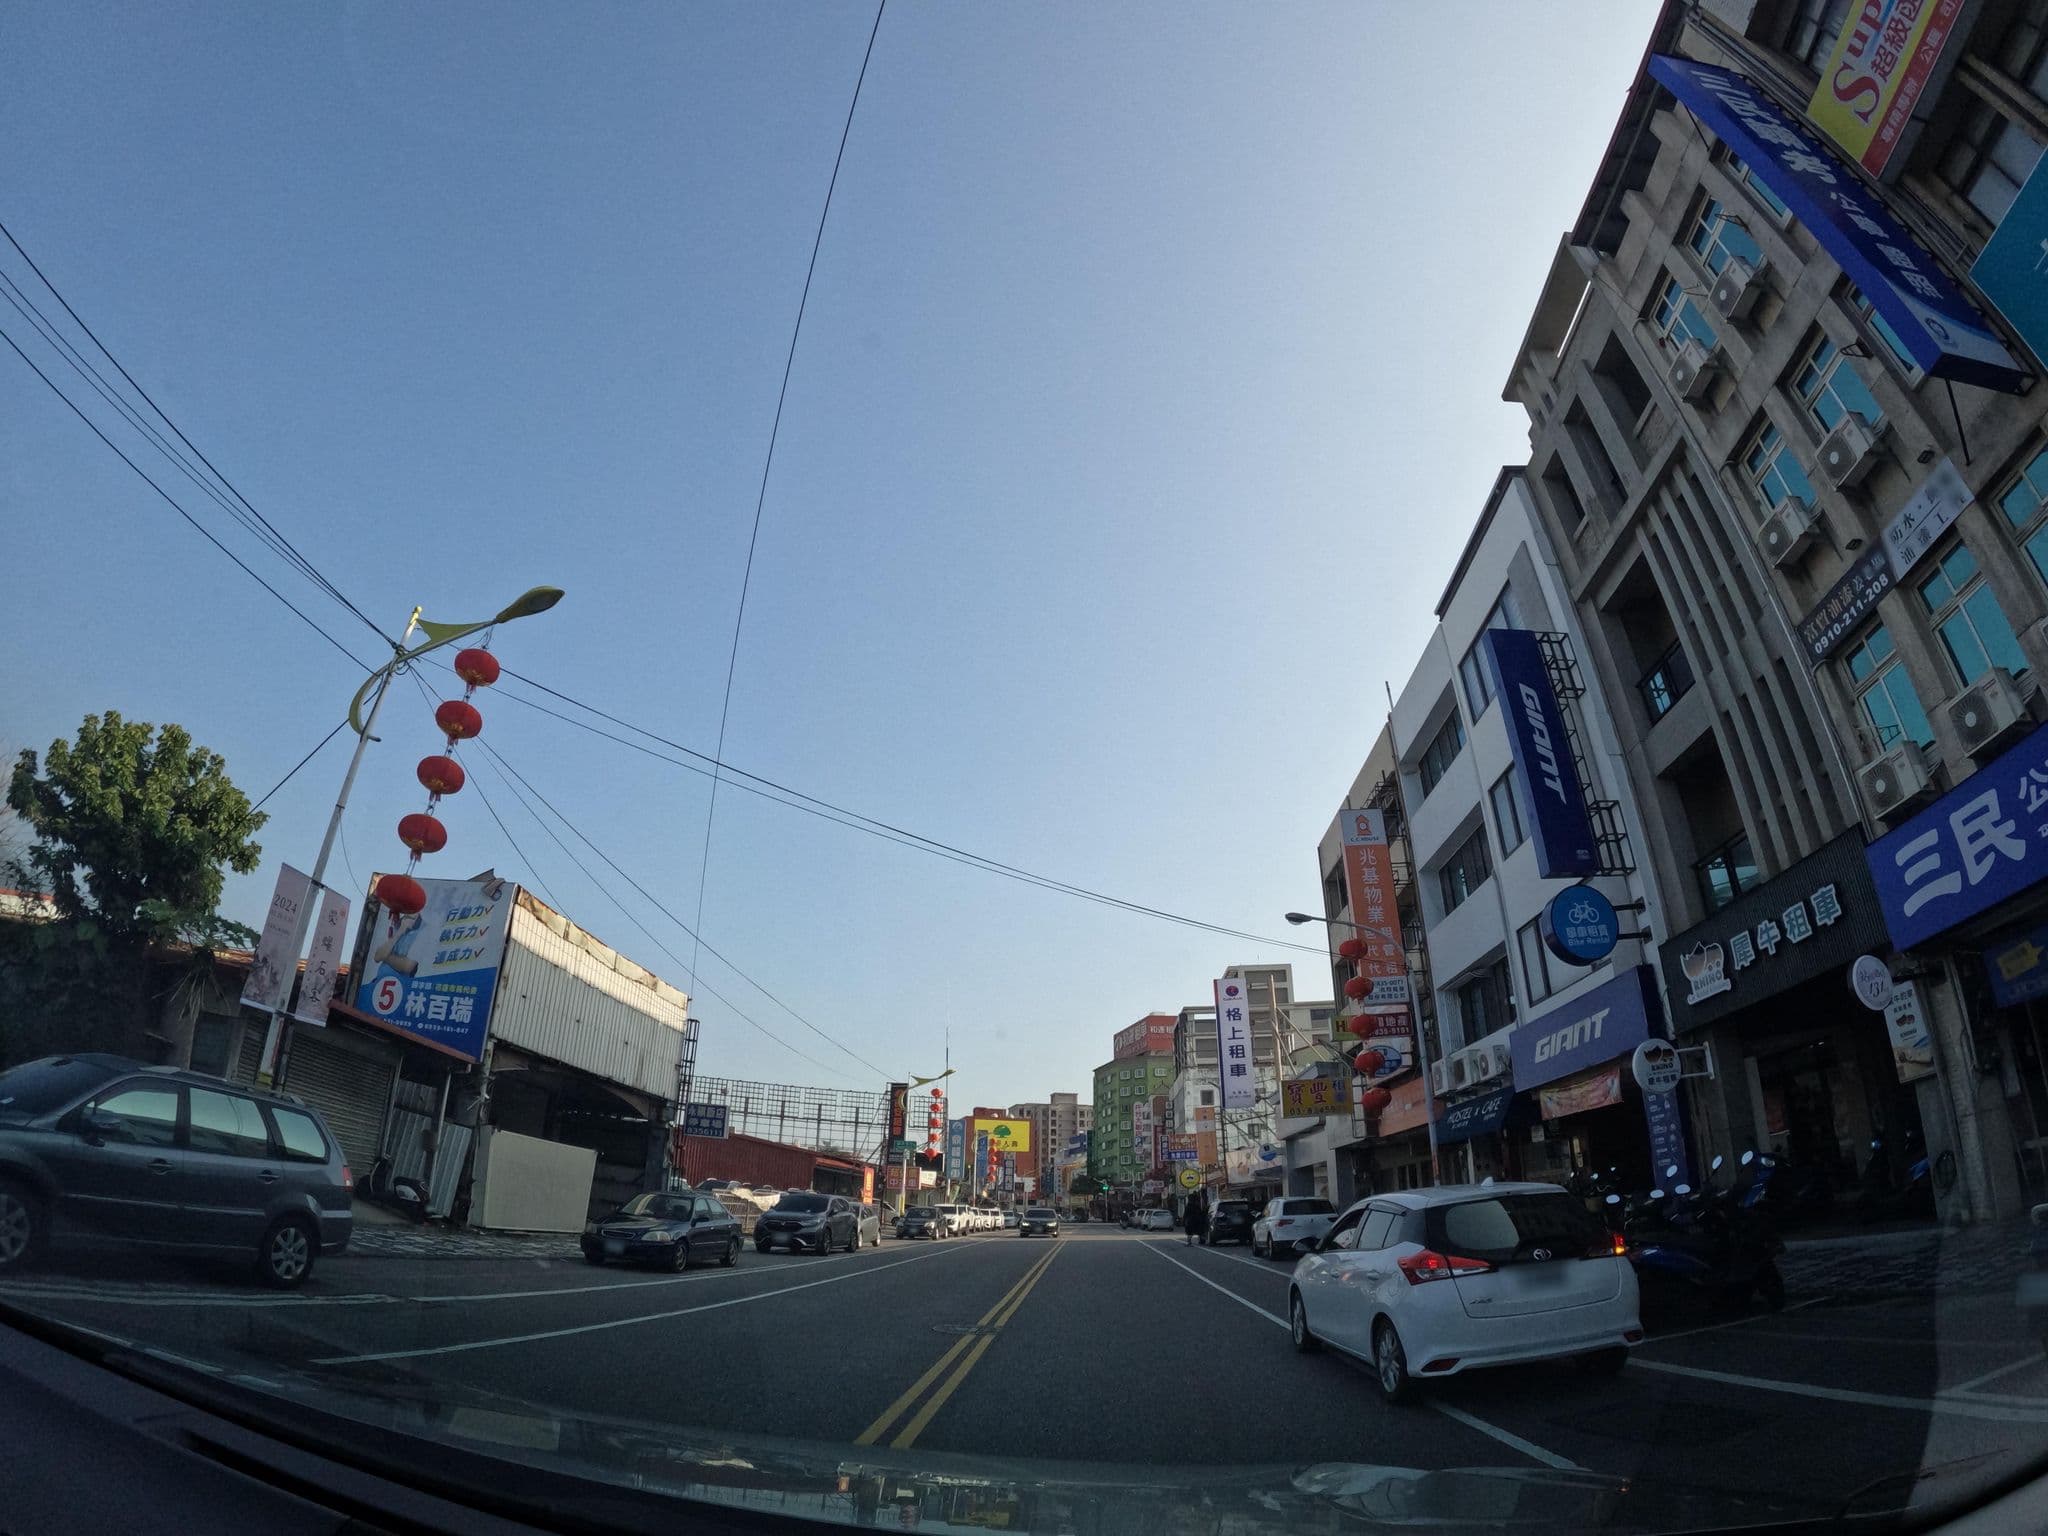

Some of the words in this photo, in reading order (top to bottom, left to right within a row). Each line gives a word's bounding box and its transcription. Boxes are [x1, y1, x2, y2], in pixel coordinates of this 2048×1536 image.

[1813, 572, 1889, 654] 0910-211-208
[1518, 682, 1567, 805] GIANT
[1894, 787, 2027, 918] 三民
[273, 893, 298, 914] 2024
[446, 905, 484, 922] 行動力
[1359, 847, 1386, 923] 兆基物業
[438, 925, 479, 943] 執行力
[1730, 883, 1842, 971] 犀牛租車
[378, 980, 397, 1011] 5
[404, 990, 474, 1024] 林百瑞
[1692, 969, 1723, 992] RHINO
[1225, 1007, 1248, 1078] 格上租車
[1534, 1007, 1611, 1064] GIANT
